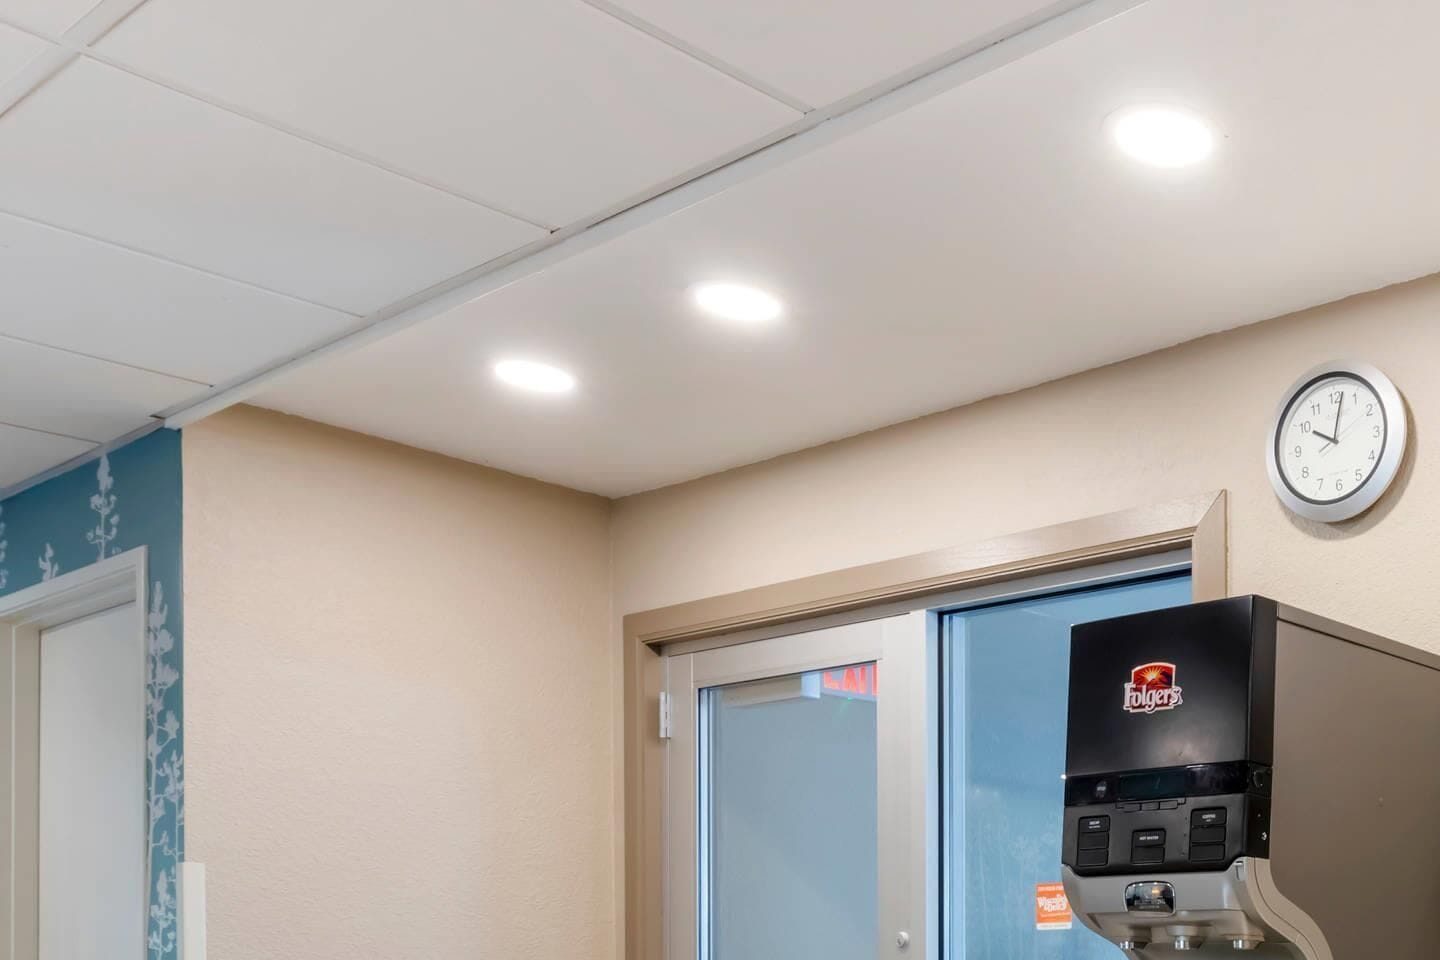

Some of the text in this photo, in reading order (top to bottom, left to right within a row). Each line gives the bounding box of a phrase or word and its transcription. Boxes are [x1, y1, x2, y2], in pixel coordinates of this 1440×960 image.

[1310, 404, 1321, 416] 11
[1366, 403, 1373, 416] 2
[1300, 421, 1311, 433] 10
[1373, 425, 1380, 438] 3
[1294, 446, 1302, 458] 9
[1368, 450, 1375, 461] 4
[1302, 467, 1309, 478] 8
[1355, 469, 1362, 481] 5
[1317, 478, 1324, 490] 7
[1335, 479, 1343, 491] 6
[1123, 683, 1180, 711] Folgers
